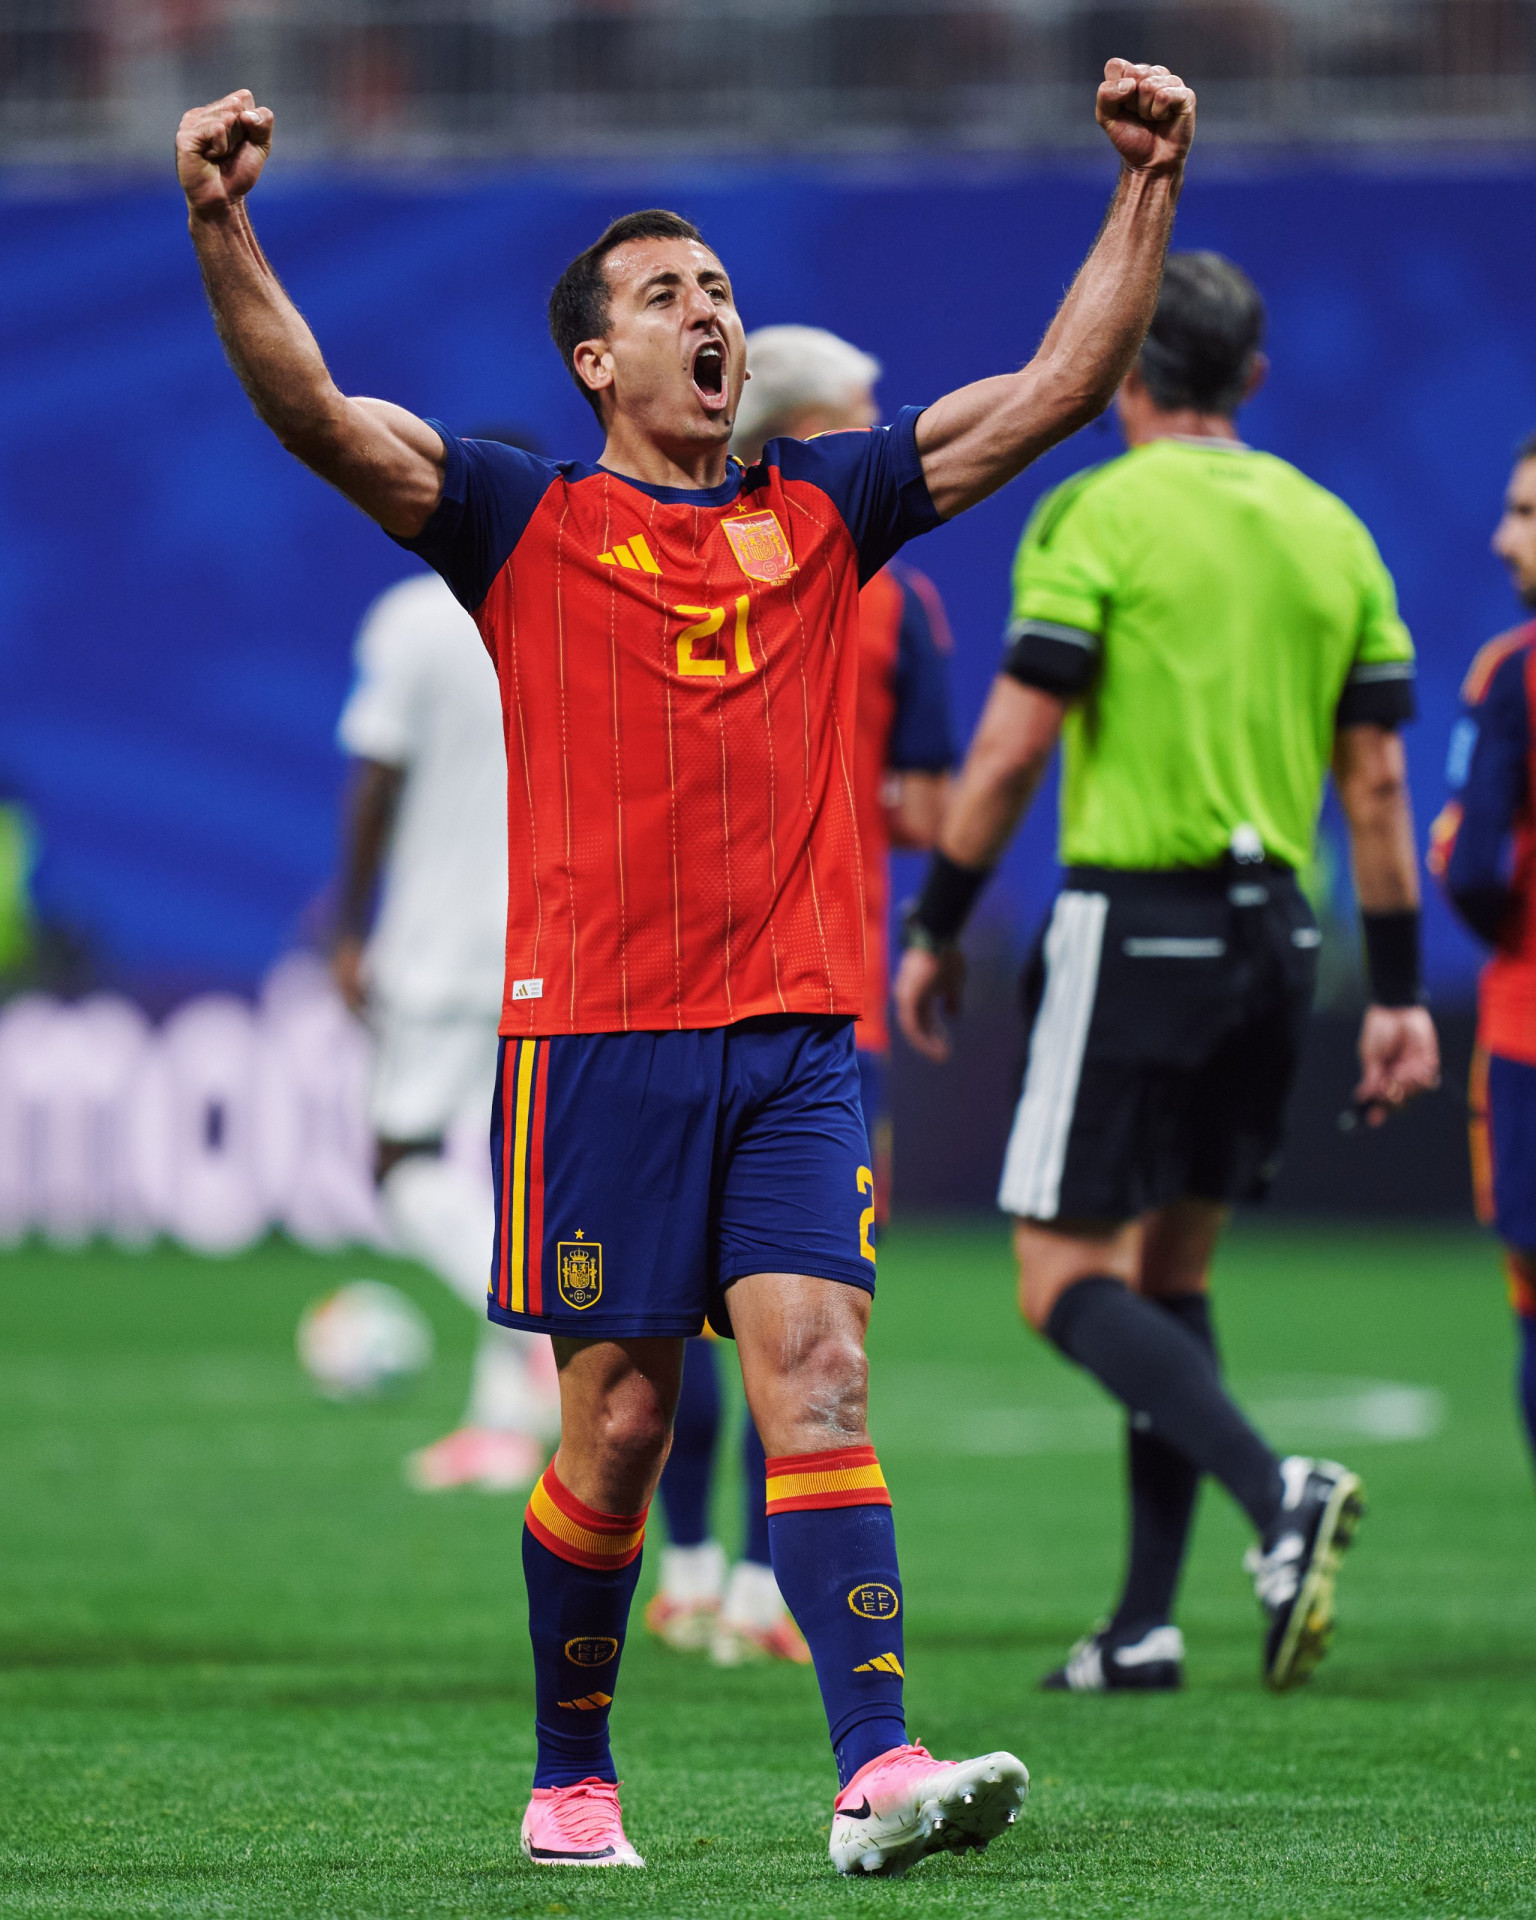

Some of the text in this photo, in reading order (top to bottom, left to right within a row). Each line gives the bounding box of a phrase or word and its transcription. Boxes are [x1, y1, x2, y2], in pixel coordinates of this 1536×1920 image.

[673, 594, 756, 676] 21
[861, 1591, 889, 1601] RF
[863, 1602, 890, 1612] EF
